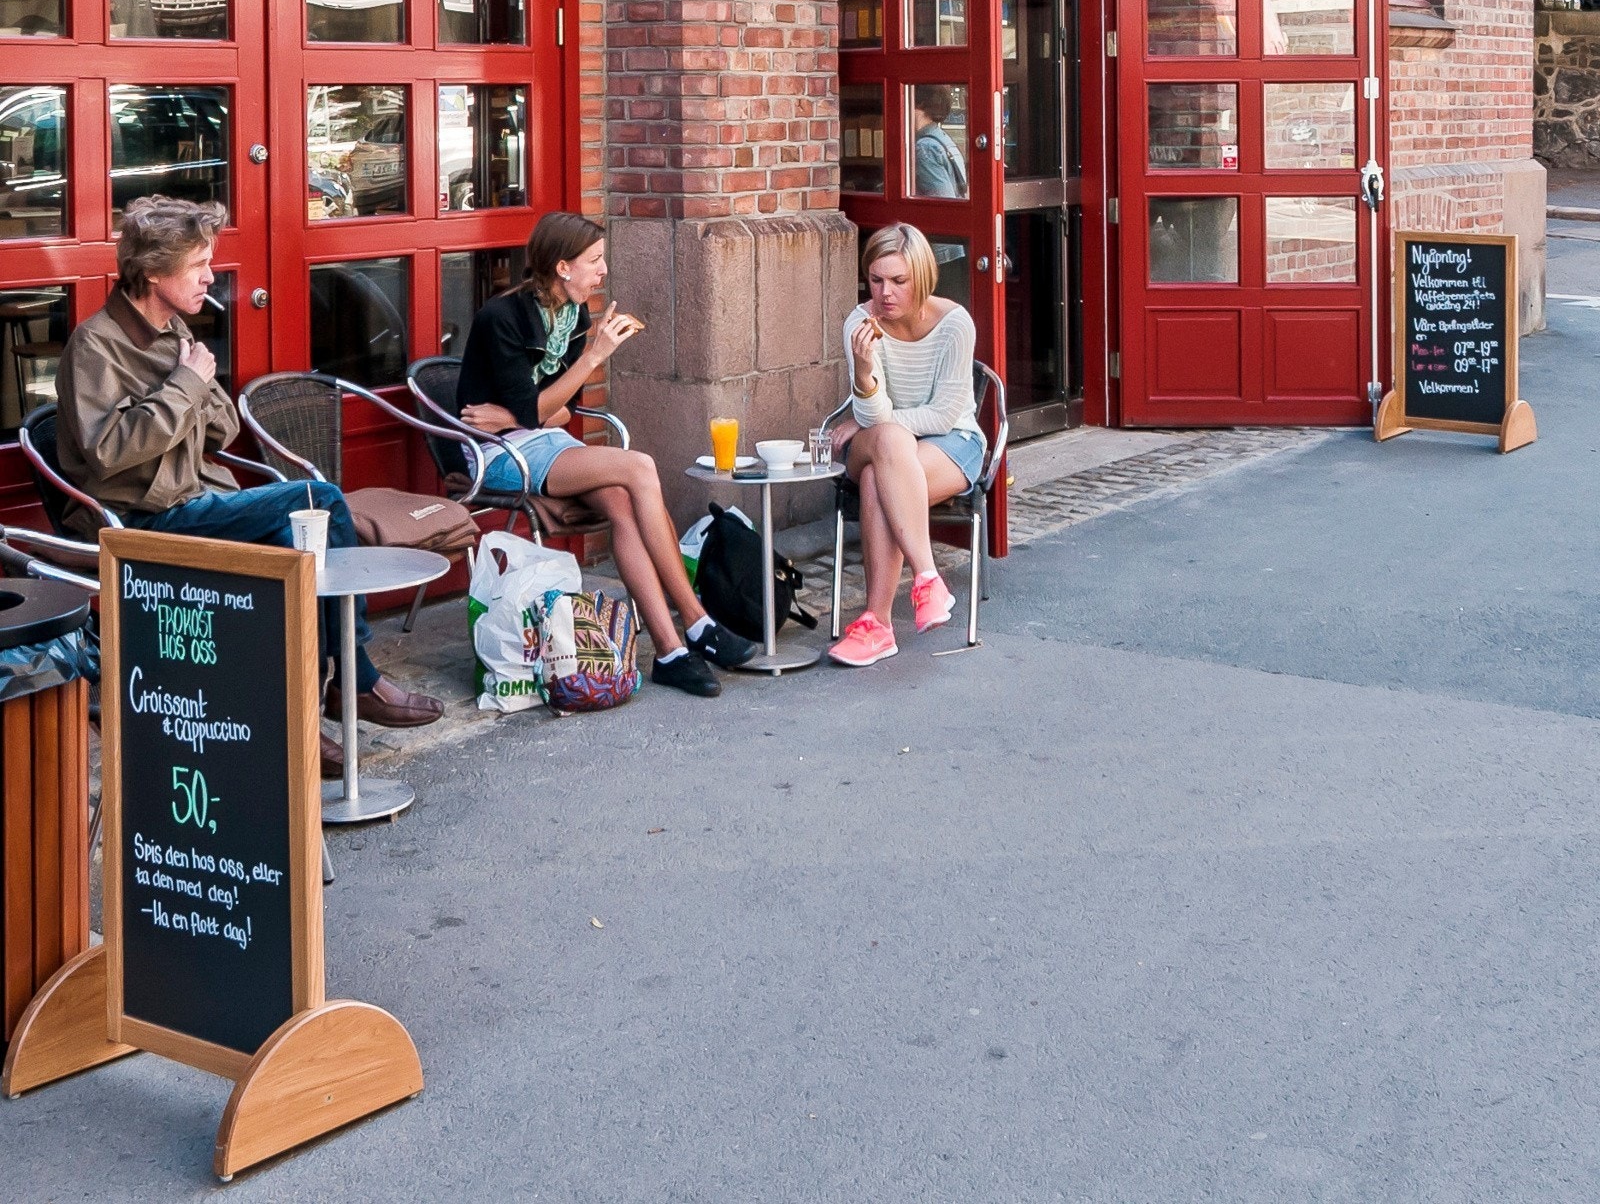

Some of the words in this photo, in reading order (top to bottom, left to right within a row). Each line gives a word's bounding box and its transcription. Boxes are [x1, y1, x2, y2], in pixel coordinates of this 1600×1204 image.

[1411, 244, 1472, 275] Nyåpning!
[1411, 273, 1469, 288] Velkommen
[1472, 276, 1487, 288] til
[1414, 289, 1496, 306] Kaffebrenneriets
[1425, 300, 1461, 312] avdeling
[1413, 317, 1437, 332] Våre
[1418, 379, 1480, 394] Velkommen!
[123, 563, 175, 612] Begynn
[180, 582, 220, 611] dagen
[224, 593, 255, 610] med
[157, 604, 215, 639] FROKOST
[158, 633, 186, 661] HOS
[191, 638, 217, 665] OSS
[129, 665, 208, 719] Croissant
[134, 832, 163, 865] Spis
[165, 845, 189, 869] den
[191, 847, 216, 873] hos
[219, 857, 250, 884] oss,
[252, 862, 284, 886] eller
[135, 867, 151, 886] ta
[152, 870, 174, 892] den
[176, 879, 202, 899] med
[208, 884, 240, 911] deg!
[172, 912, 189, 931] en
[190, 911, 220, 937] flott
[223, 916, 252, 950] dag!
